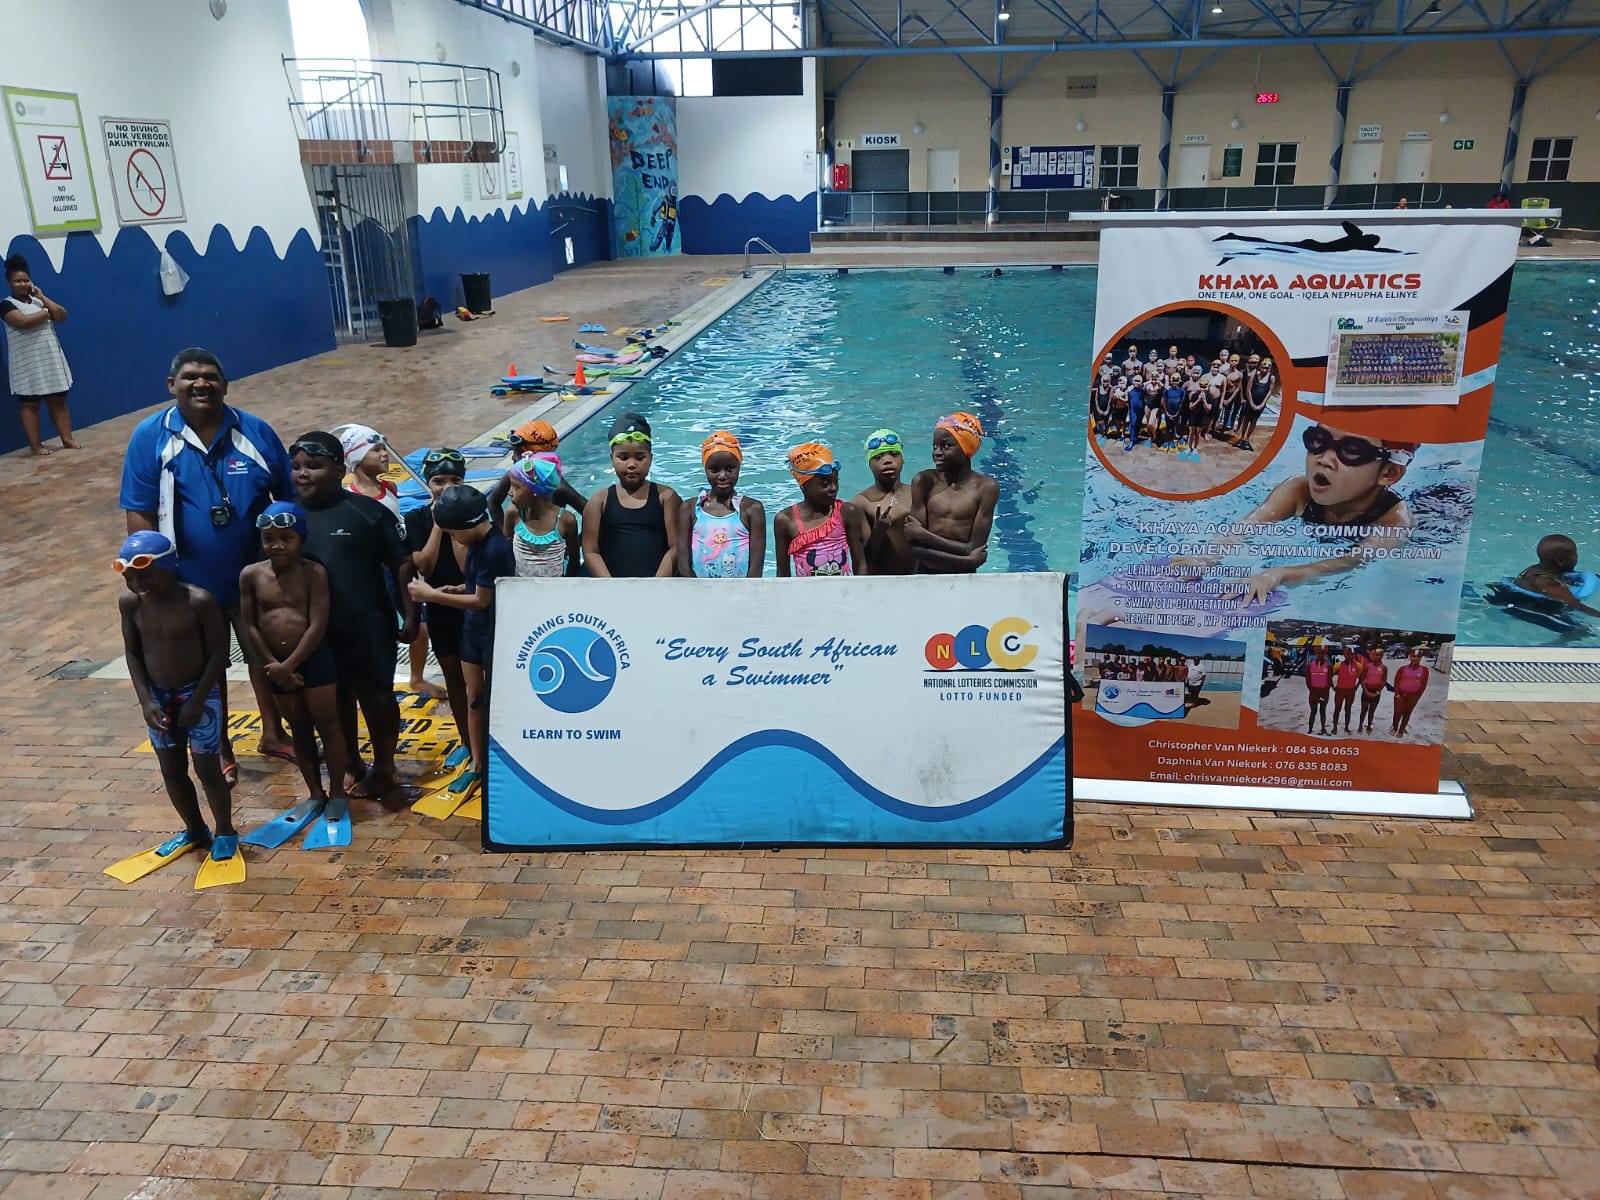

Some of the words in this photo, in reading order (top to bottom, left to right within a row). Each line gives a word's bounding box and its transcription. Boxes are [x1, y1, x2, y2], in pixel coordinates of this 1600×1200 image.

[865, 136, 898, 144] KIOSK
[630, 149, 673, 169] DEEP
[642, 173, 669, 189] END
[1199, 273, 1279, 290] KHAYA
[1289, 273, 1421, 290] AQUATICS
[1198, 291, 1217, 299] ONE
[1219, 291, 1246, 300] TEAM,
[1249, 291, 1268, 299] ONE
[1270, 291, 1295, 300] GOAL
[1302, 291, 1329, 301] IQELA
[1331, 291, 1383, 299] NEPHUPHA
[1386, 290, 1418, 299] ELINYE
[1139, 522, 1200, 534] KHAYA
[1205, 522, 1296, 536] AQUATICS
[1302, 524, 1416, 538] COMMUNITY
[1110, 542, 1243, 556] DEVELOPMENT
[1250, 545, 1345, 558] SWIMMING
[1351, 547, 1442, 560] PROGRAM
[1127, 564, 1160, 576] LEARN
[1160, 565, 1174, 576] TO
[1174, 565, 1202, 577] SWIM
[1204, 566, 1251, 577] PROGRAM
[1126, 580, 1155, 592] SWIM
[1157, 581, 1193, 593] STROKE
[1194, 582, 1251, 594] CORRECTION
[1125, 597, 1153, 608] SWIM
[1175, 599, 1238, 610] COMPETITION
[1124, 612, 1154, 624] BEACH
[1156, 614, 1195, 626] NIPPERS
[1204, 615, 1219, 627] WP
[1221, 616, 1267, 628] BIATHLON
[515, 615, 565, 670] SWIMMING
[568, 613, 607, 630] SOUTH
[606, 628, 631, 670] AFRICA
[738, 637, 803, 658] South
[810, 637, 898, 663] African
[702, 674, 717, 686] a
[923, 678, 957, 688] NATIONAL
[958, 678, 992, 688] LOTTERIES
[994, 678, 1038, 688] COMMISSION
[940, 692, 973, 700] LOTTO
[979, 692, 1022, 700] FUNDED
[522, 729, 563, 739] LEARN
[566, 729, 582, 739] TO
[586, 729, 621, 739] SWIM
[1148, 740, 1212, 752] Christopher
[1214, 743, 1235, 752] Van
[1237, 743, 1278, 753] Niekerk
[1286, 745, 1306, 754] 084
[1310, 746, 1329, 755] 584
[1332, 746, 1360, 756] 0653
[1158, 756, 1202, 768] Daphnia
[1204, 758, 1224, 767] Van
[1227, 759, 1267, 769] Niekerk
[1275, 761, 1295, 770] 076
[1298, 762, 1317, 771] 835
[1320, 762, 1348, 772] 8083
[1150, 772, 1182, 781] Email:
[1184, 772, 1353, 788] chrisvanniekerk296@gmail.com
